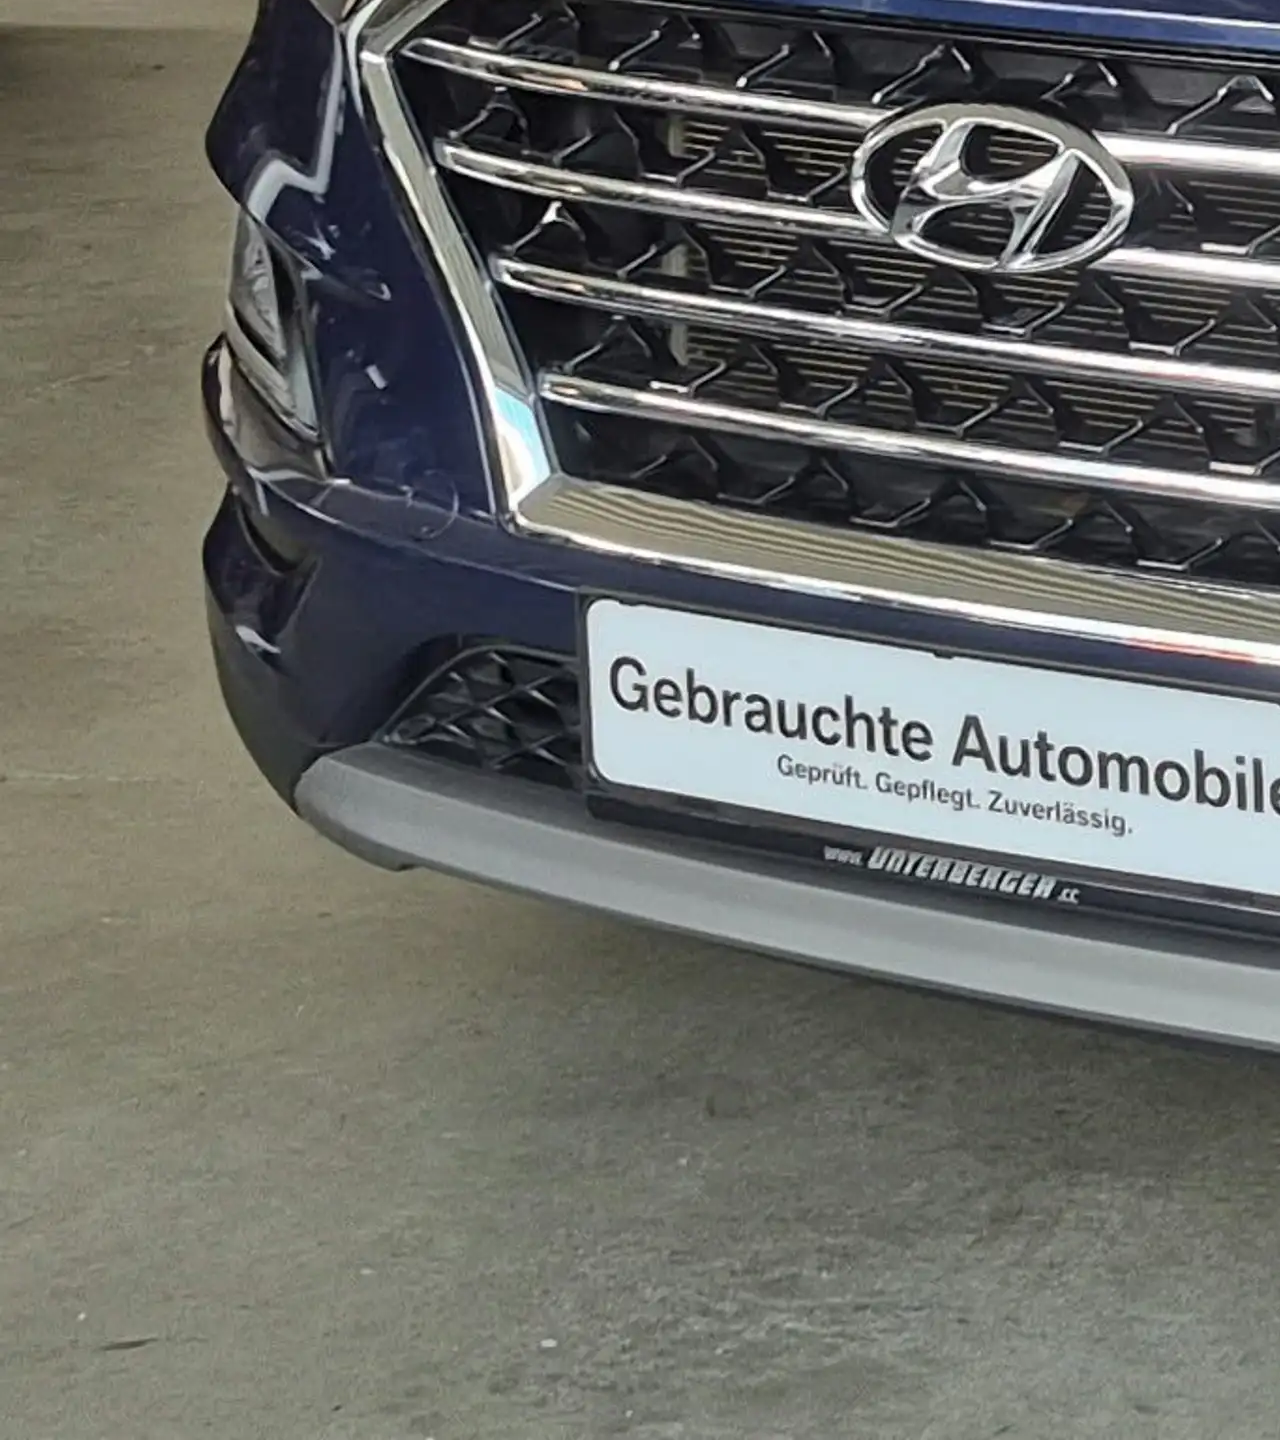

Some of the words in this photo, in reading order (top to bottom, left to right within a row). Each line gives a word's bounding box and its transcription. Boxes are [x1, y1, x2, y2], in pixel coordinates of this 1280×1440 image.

[609, 654, 934, 763] Gebrauchte
[776, 753, 869, 793] Geprüft.
[875, 769, 981, 814] Gepflegt.
[987, 788, 1136, 838] Zuverlässig.
